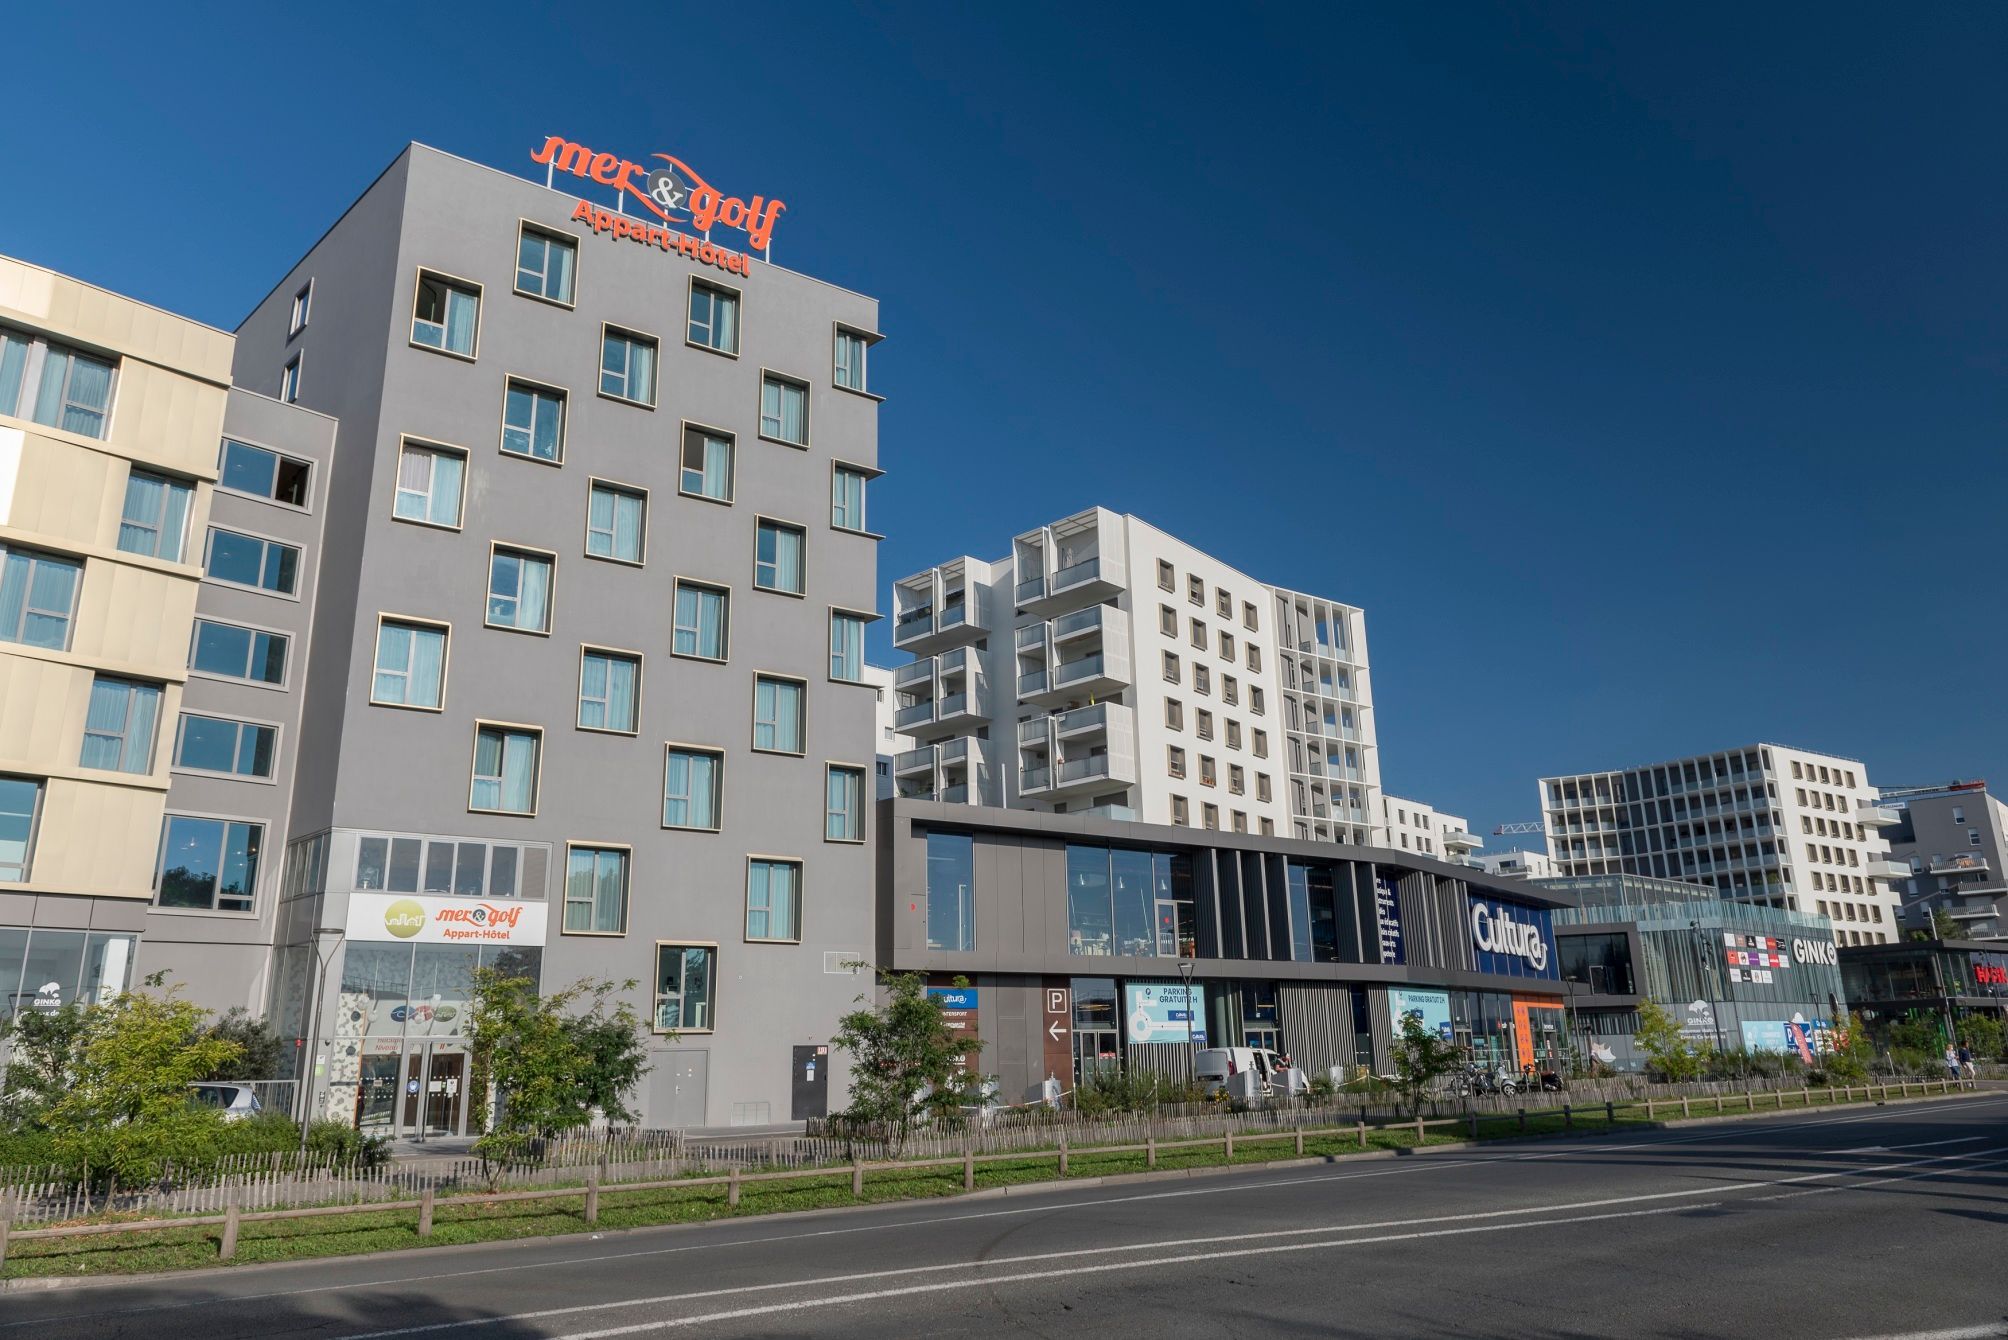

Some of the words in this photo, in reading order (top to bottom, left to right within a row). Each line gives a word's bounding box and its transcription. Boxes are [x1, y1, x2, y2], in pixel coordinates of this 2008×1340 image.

[531, 136, 660, 205] mer
[650, 175, 685, 208] &
[678, 170, 786, 250] golf
[572, 199, 750, 278] Appart-Hôtel
[436, 908, 477, 924] mer
[484, 905, 523, 928] golf
[444, 929, 510, 940] Appart-Hôtel
[1472, 903, 1547, 970] Cultura
[1793, 938, 1837, 966] GINKO
[943, 994, 967, 1004] ultura
[1052, 992, 1063, 1009] P
[1163, 988, 1192, 996] PARKING
